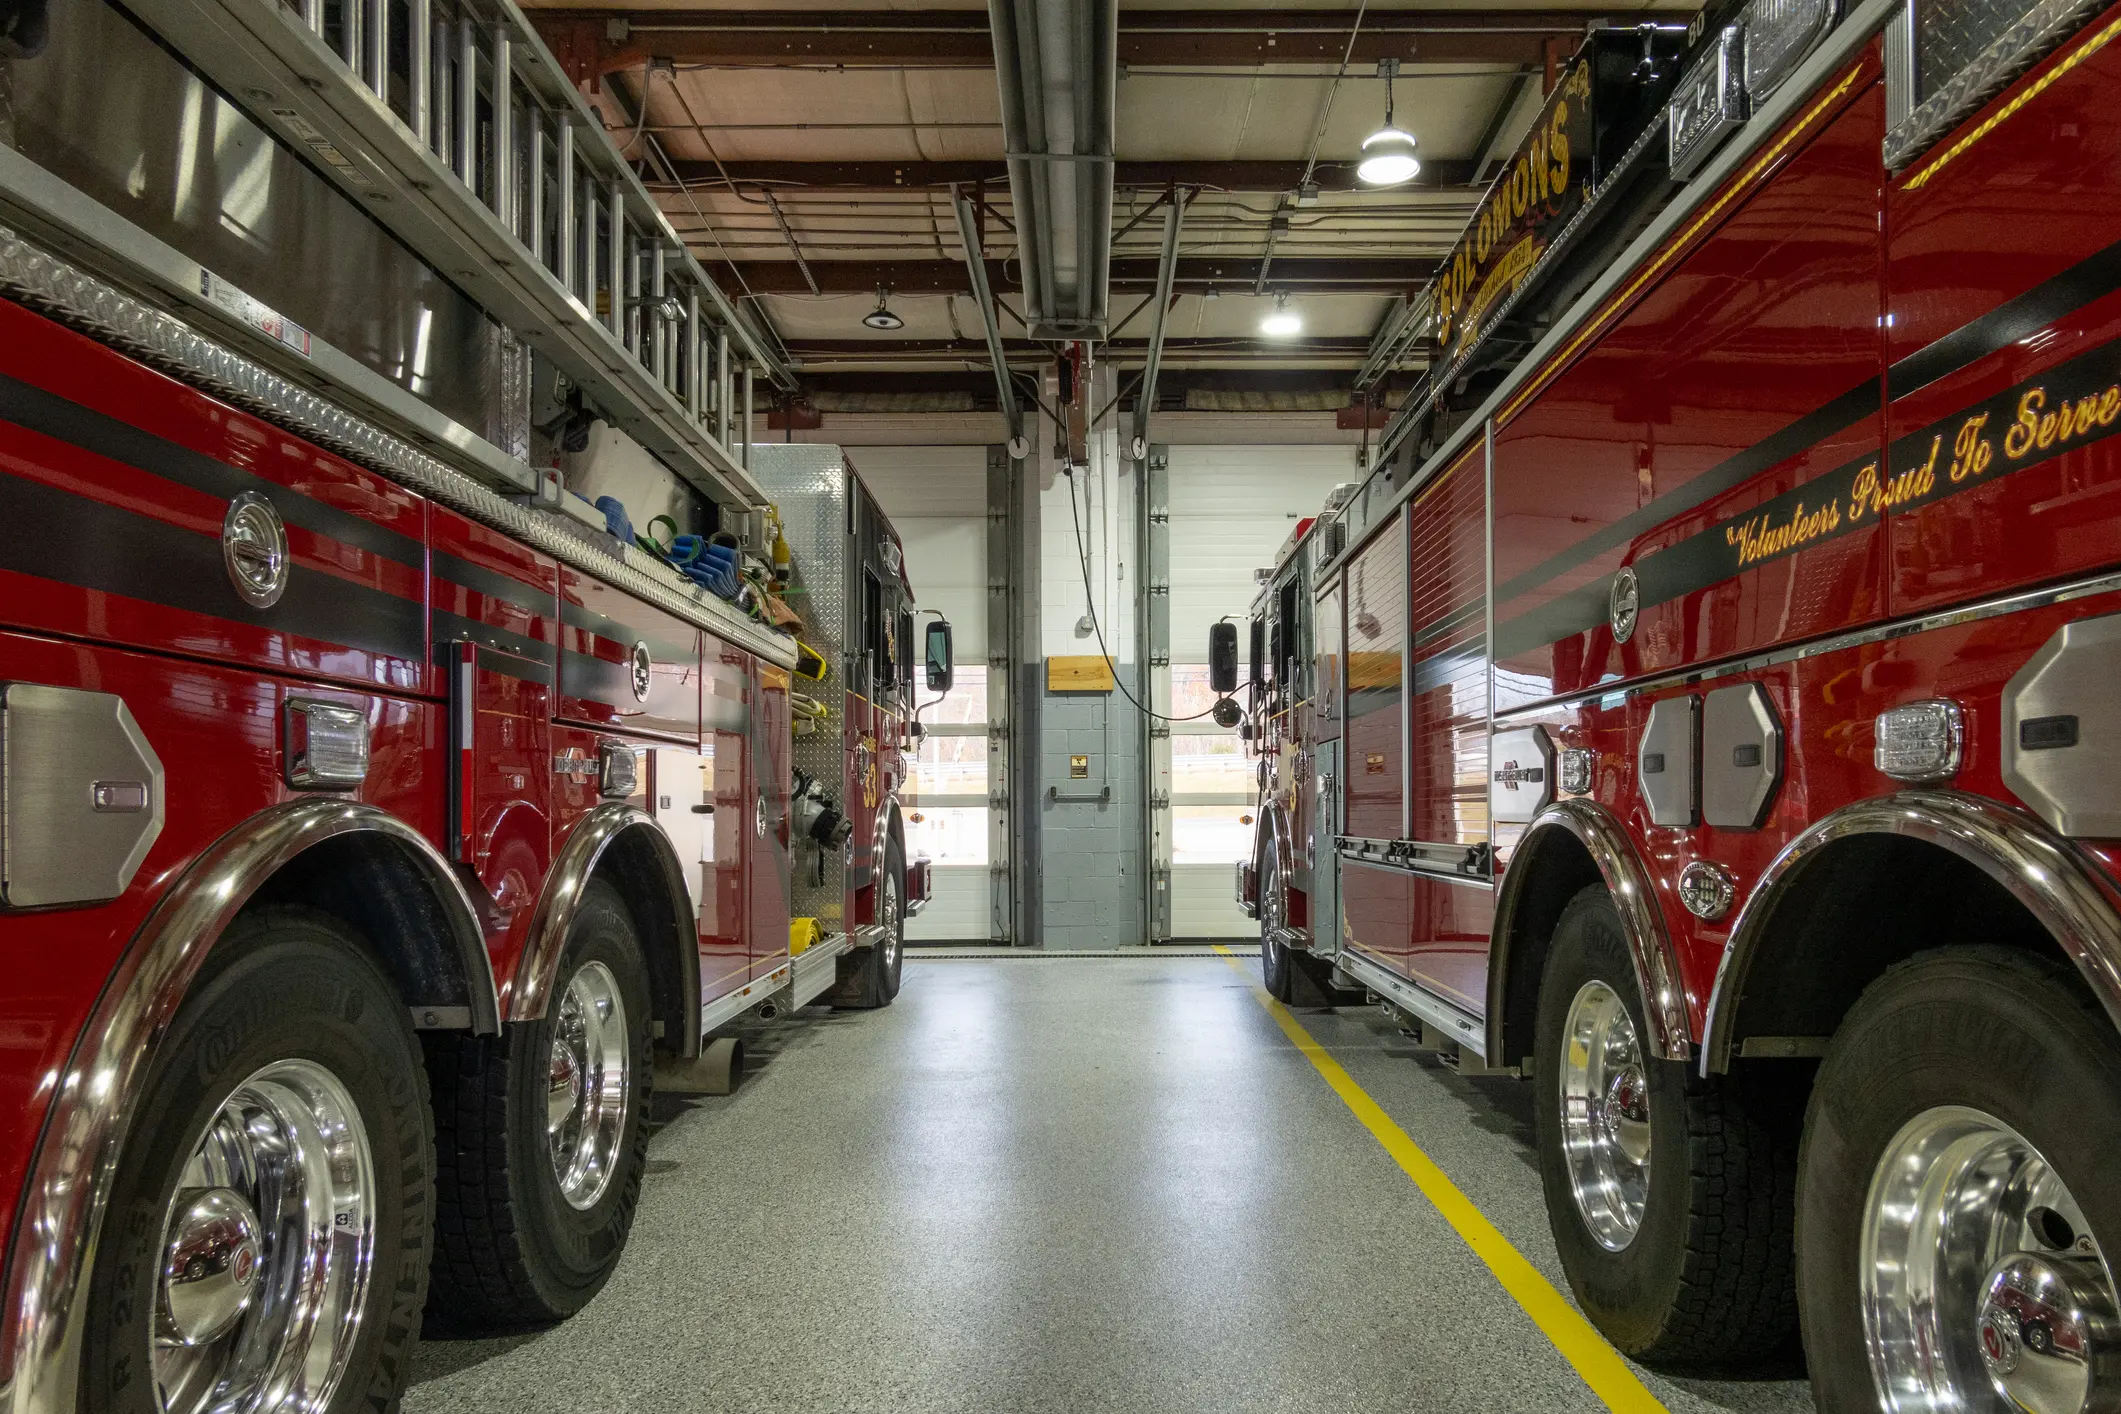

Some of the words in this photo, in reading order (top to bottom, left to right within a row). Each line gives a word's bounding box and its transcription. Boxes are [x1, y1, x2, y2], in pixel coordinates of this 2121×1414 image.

[1688, 11, 1705, 48] 80
[1440, 101, 1569, 346] SOLOMONS
[1848, 434, 1942, 522] Proud
[1950, 410, 1993, 484] To
[2004, 384, 2121, 461] Serve
[864, 763, 876, 808] 33
